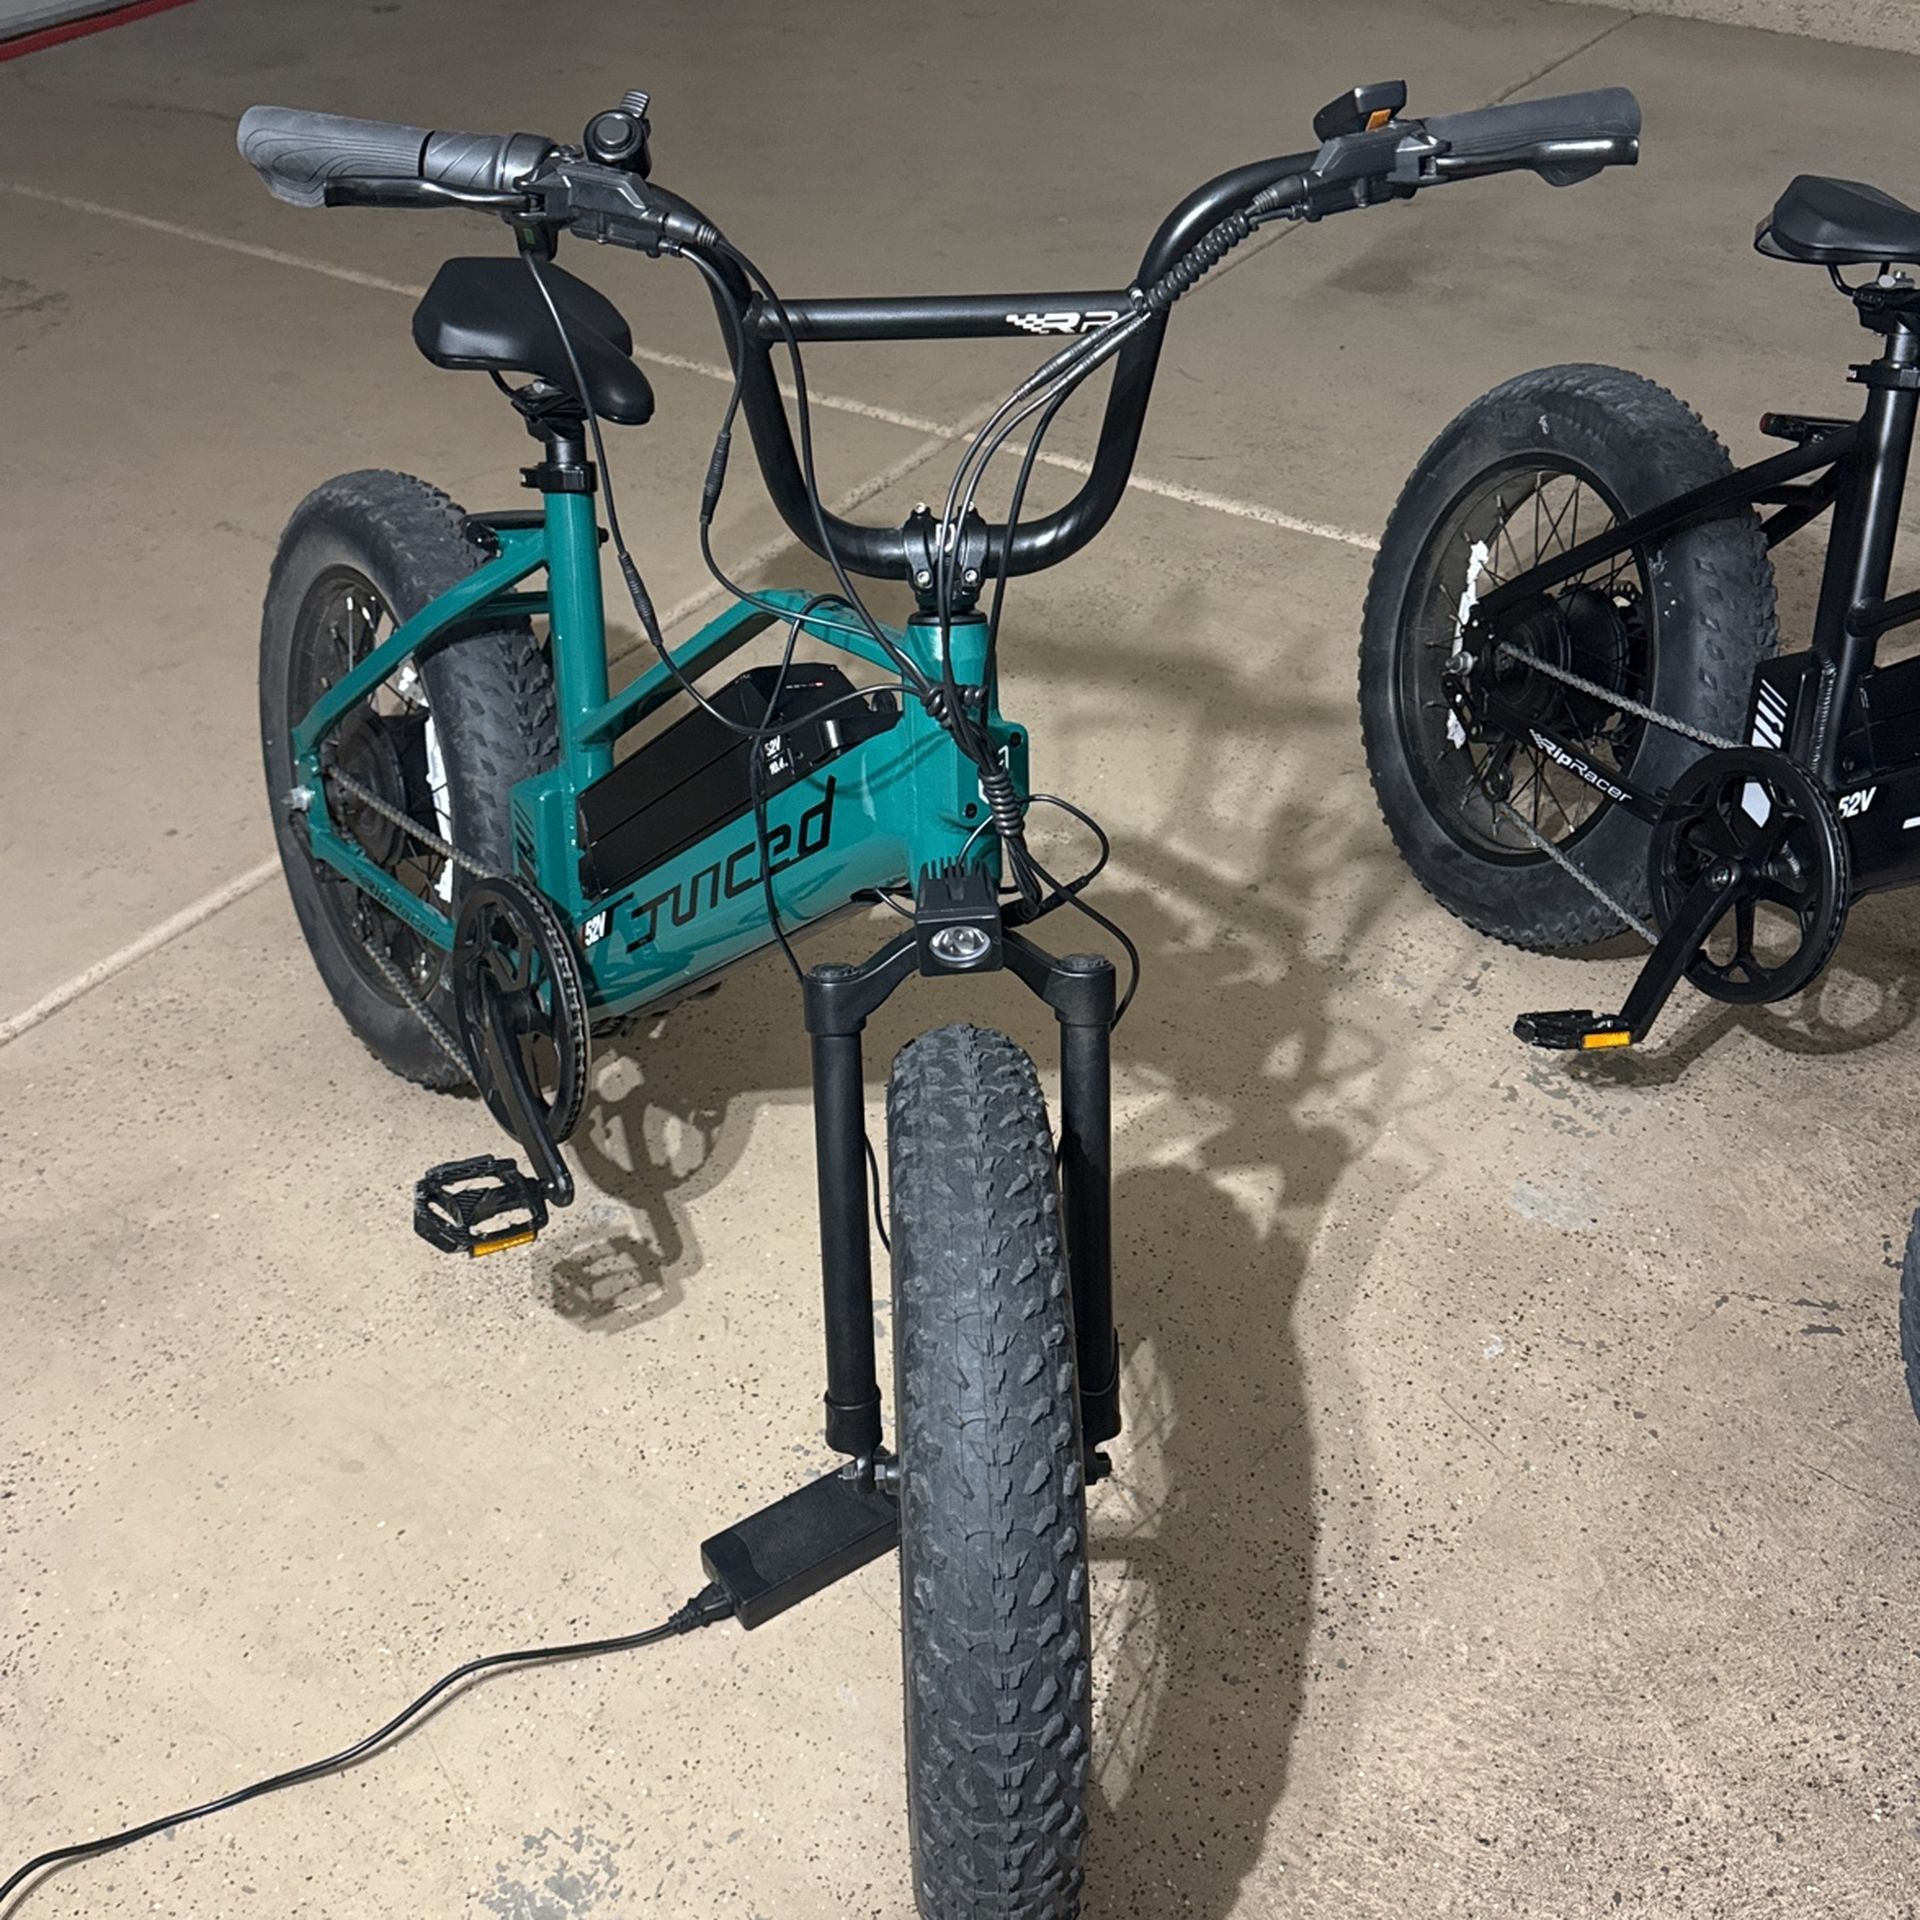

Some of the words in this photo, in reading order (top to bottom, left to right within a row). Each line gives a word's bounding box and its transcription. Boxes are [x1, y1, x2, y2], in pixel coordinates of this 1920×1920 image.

[1533, 731, 1633, 802] RipRacer
[1838, 786, 1876, 820] 52V
[584, 911, 607, 947] 52V
